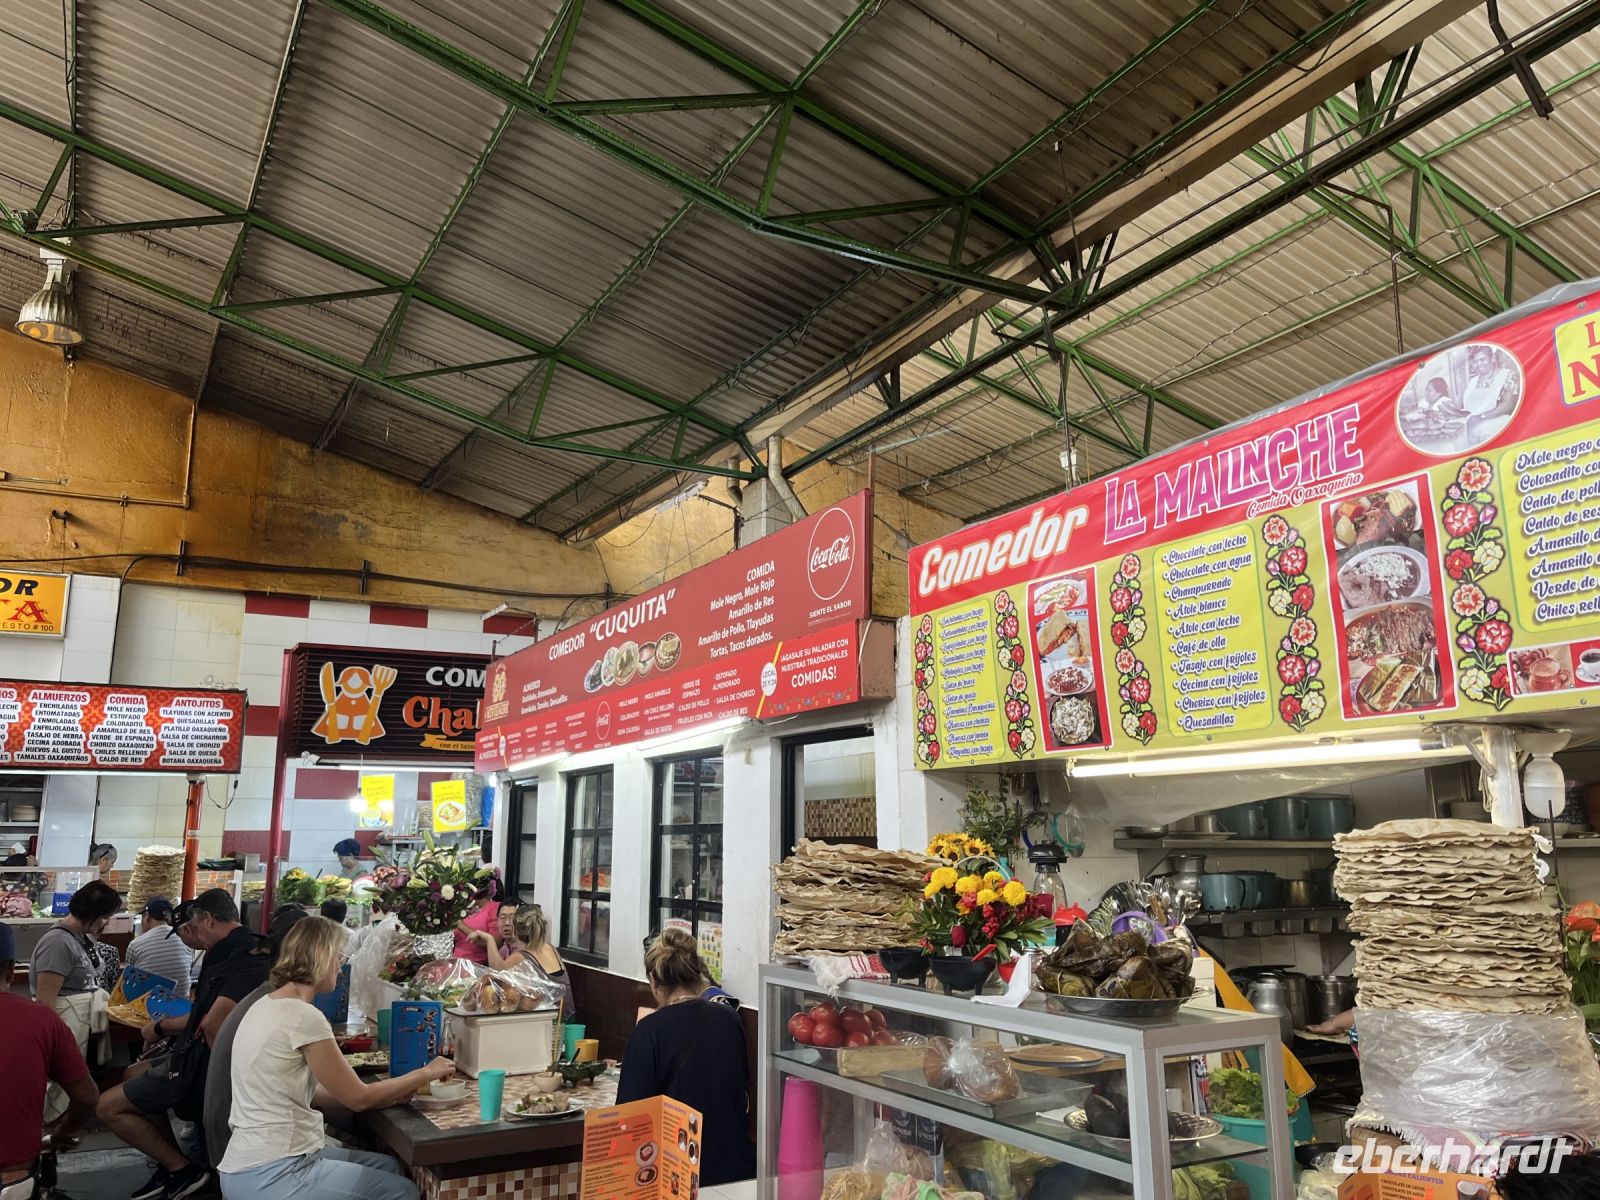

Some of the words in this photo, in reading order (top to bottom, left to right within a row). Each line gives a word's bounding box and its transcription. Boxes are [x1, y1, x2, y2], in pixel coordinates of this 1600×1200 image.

[1517, 449, 1551, 471] Mole
[1556, 440, 1592, 464] negro
[1104, 477, 1146, 545] LA
[1153, 403, 1364, 530] MALINCHE
[1519, 465, 1580, 491] Coloradito
[1247, 493, 1288, 519] Comida
[1290, 471, 1363, 507] Oaxaqueña
[1523, 492, 1556, 512] Caldo
[1560, 489, 1574, 502] de
[1526, 515, 1560, 534] Caldo
[1563, 511, 1578, 524] de
[919, 507, 1087, 596] Comedor
[1169, 546, 1206, 564] Chocolate
[1208, 542, 1222, 554] con
[1225, 534, 1247, 549] leche
[1528, 531, 1589, 555] Amarillo
[747, 560, 775, 582] COMIDA
[1213, 560, 1226, 571] con
[1230, 554, 1251, 570] agua
[1532, 553, 1592, 576] Amarillo
[710, 598, 724, 611] Mole
[725, 592, 743, 606] Negro,
[744, 584, 759, 598] Mole
[760, 577, 775, 592] Rojo
[1171, 577, 1231, 599] Champurrado
[1534, 579, 1575, 598] Verde
[1580, 574, 1595, 588] de
[728, 602, 753, 620] Amarillo
[754, 599, 762, 610] de
[763, 595, 775, 607] Res
[809, 607, 826, 618] SIENTE
[827, 605, 833, 613] EL
[833, 600, 851, 611] SABOR
[1174, 605, 1197, 619] Atole
[1200, 598, 1226, 613] blanco
[1537, 602, 1574, 619] Chiles
[698, 629, 721, 647] Amarillo
[721, 628, 729, 639] de
[729, 622, 746, 637] Pollo,
[746, 613, 774, 631] Tlayudas
[1175, 622, 1199, 636] Atole
[1202, 620, 1216, 632] con
[1218, 614, 1240, 629] leche
[549, 632, 586, 660] COMEDOR
[729, 641, 746, 653] Tacos
[804, 648, 811, 656] SU
[812, 642, 836, 655] PALADAR
[836, 637, 848, 648] CON
[1177, 640, 1197, 657] Café
[1199, 638, 1208, 650] de
[1211, 635, 1225, 648] olla
[806, 649, 848, 666] TRADICIONALES
[1179, 657, 1207, 674] Tasajo
[1209, 656, 1223, 667] con
[1225, 650, 1256, 668] frijoles
[713, 678, 741, 691] ALMENDRADO
[716, 669, 737, 681] ESTOFADO
[791, 666, 837, 688] COMIDAS!
[1180, 677, 1208, 691] Cecina
[1211, 675, 1225, 686] con
[1227, 670, 1258, 688] frijoles
[32, 692, 87, 703] ALMUERZOS
[109, 696, 145, 705] COMIDA
[175, 699, 221, 708] ANTOJITOS
[678, 703, 691, 712] CALDO
[697, 698, 710, 708] POLLO
[716, 695, 730, 705] SALSA
[736, 689, 756, 700] CHORIZO
[1182, 697, 1214, 711] Chorizo
[1217, 694, 1231, 706] con
[1233, 689, 1265, 708] frijoles
[1184, 713, 1234, 730] Quesadillas
